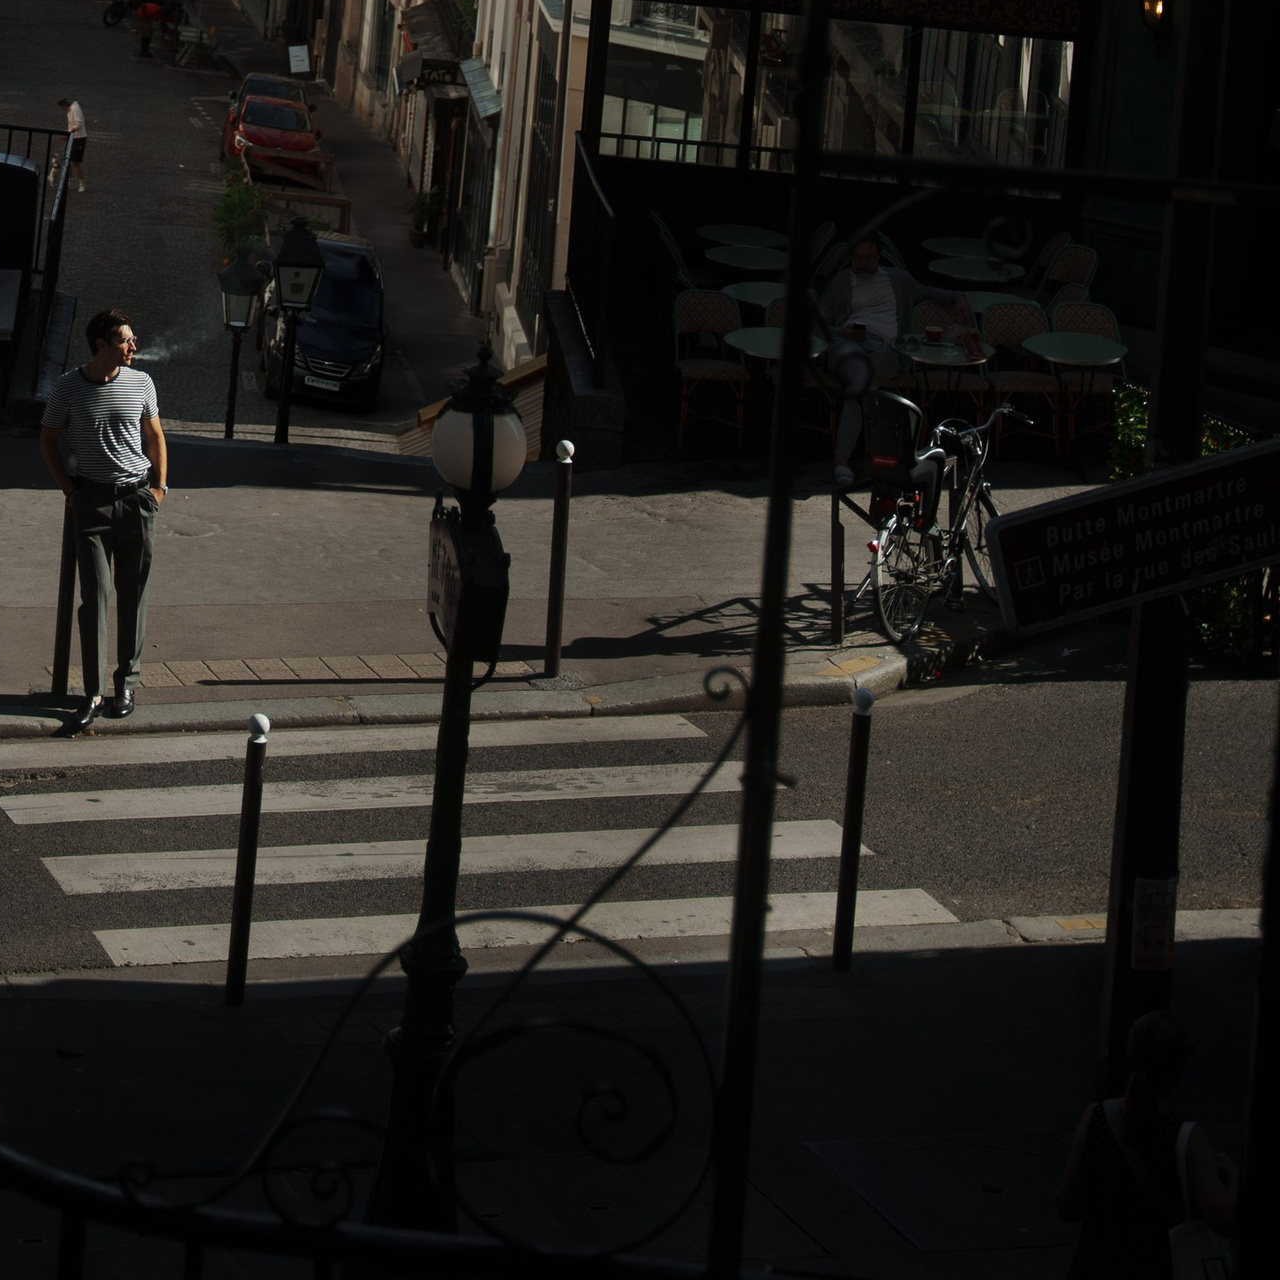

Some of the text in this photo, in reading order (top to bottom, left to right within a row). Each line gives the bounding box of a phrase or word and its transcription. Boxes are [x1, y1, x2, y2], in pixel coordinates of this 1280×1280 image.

[1046, 476, 1248, 548] Butte Montmartre
[1052, 501, 1266, 577] Musée Montmartre
[1059, 578, 1095, 606] Par
[1105, 569, 1124, 591] la
[1134, 559, 1169, 582] rue
[1229, 524, 1280, 556] Saul
